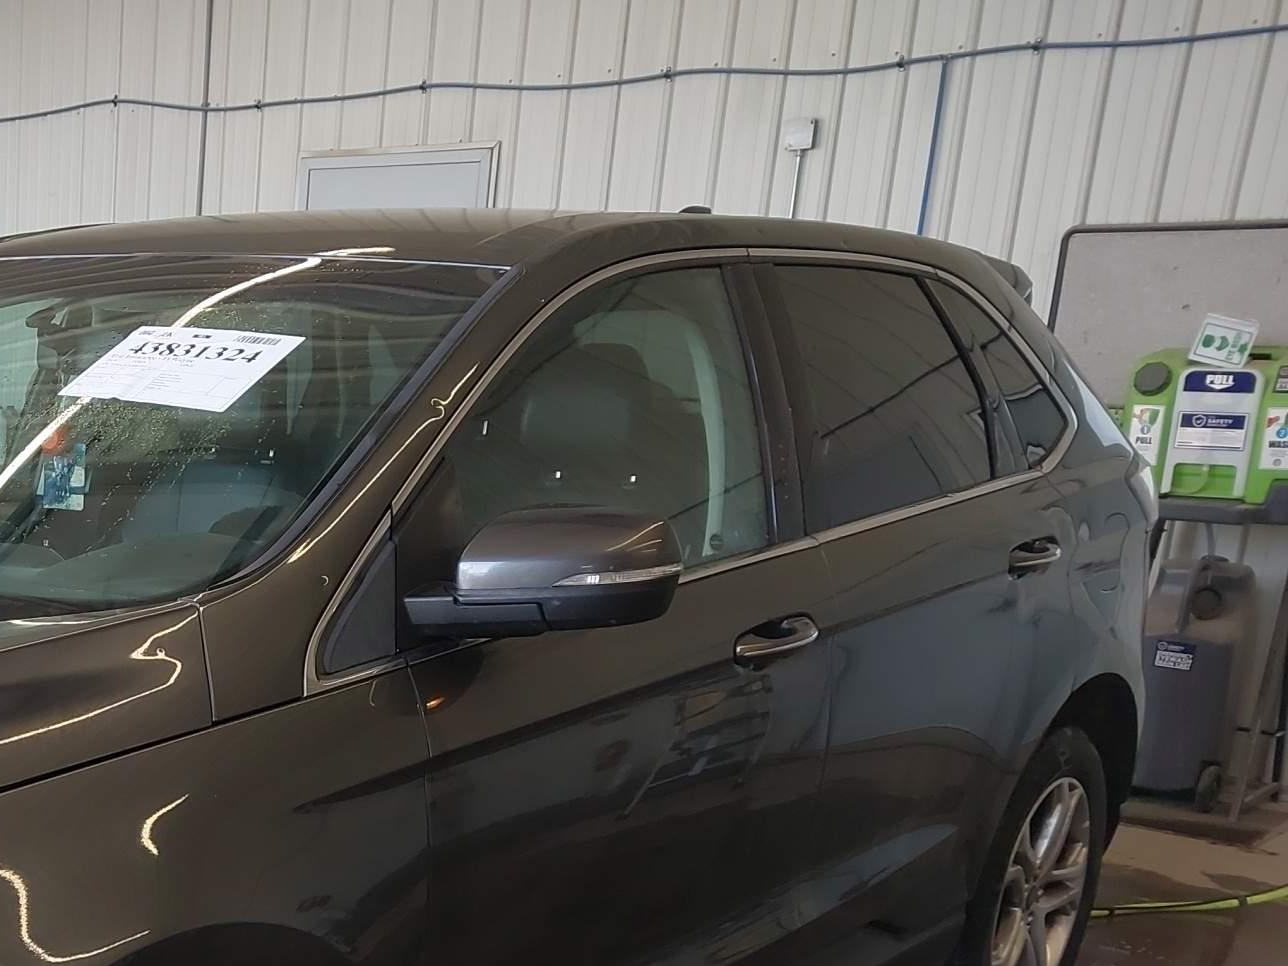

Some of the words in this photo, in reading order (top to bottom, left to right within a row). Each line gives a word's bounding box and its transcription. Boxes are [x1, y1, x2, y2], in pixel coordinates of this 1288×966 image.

[129, 340, 264, 364] 43831324
[1206, 374, 1235, 385] PULL
[1134, 436, 1153, 445] PULL
